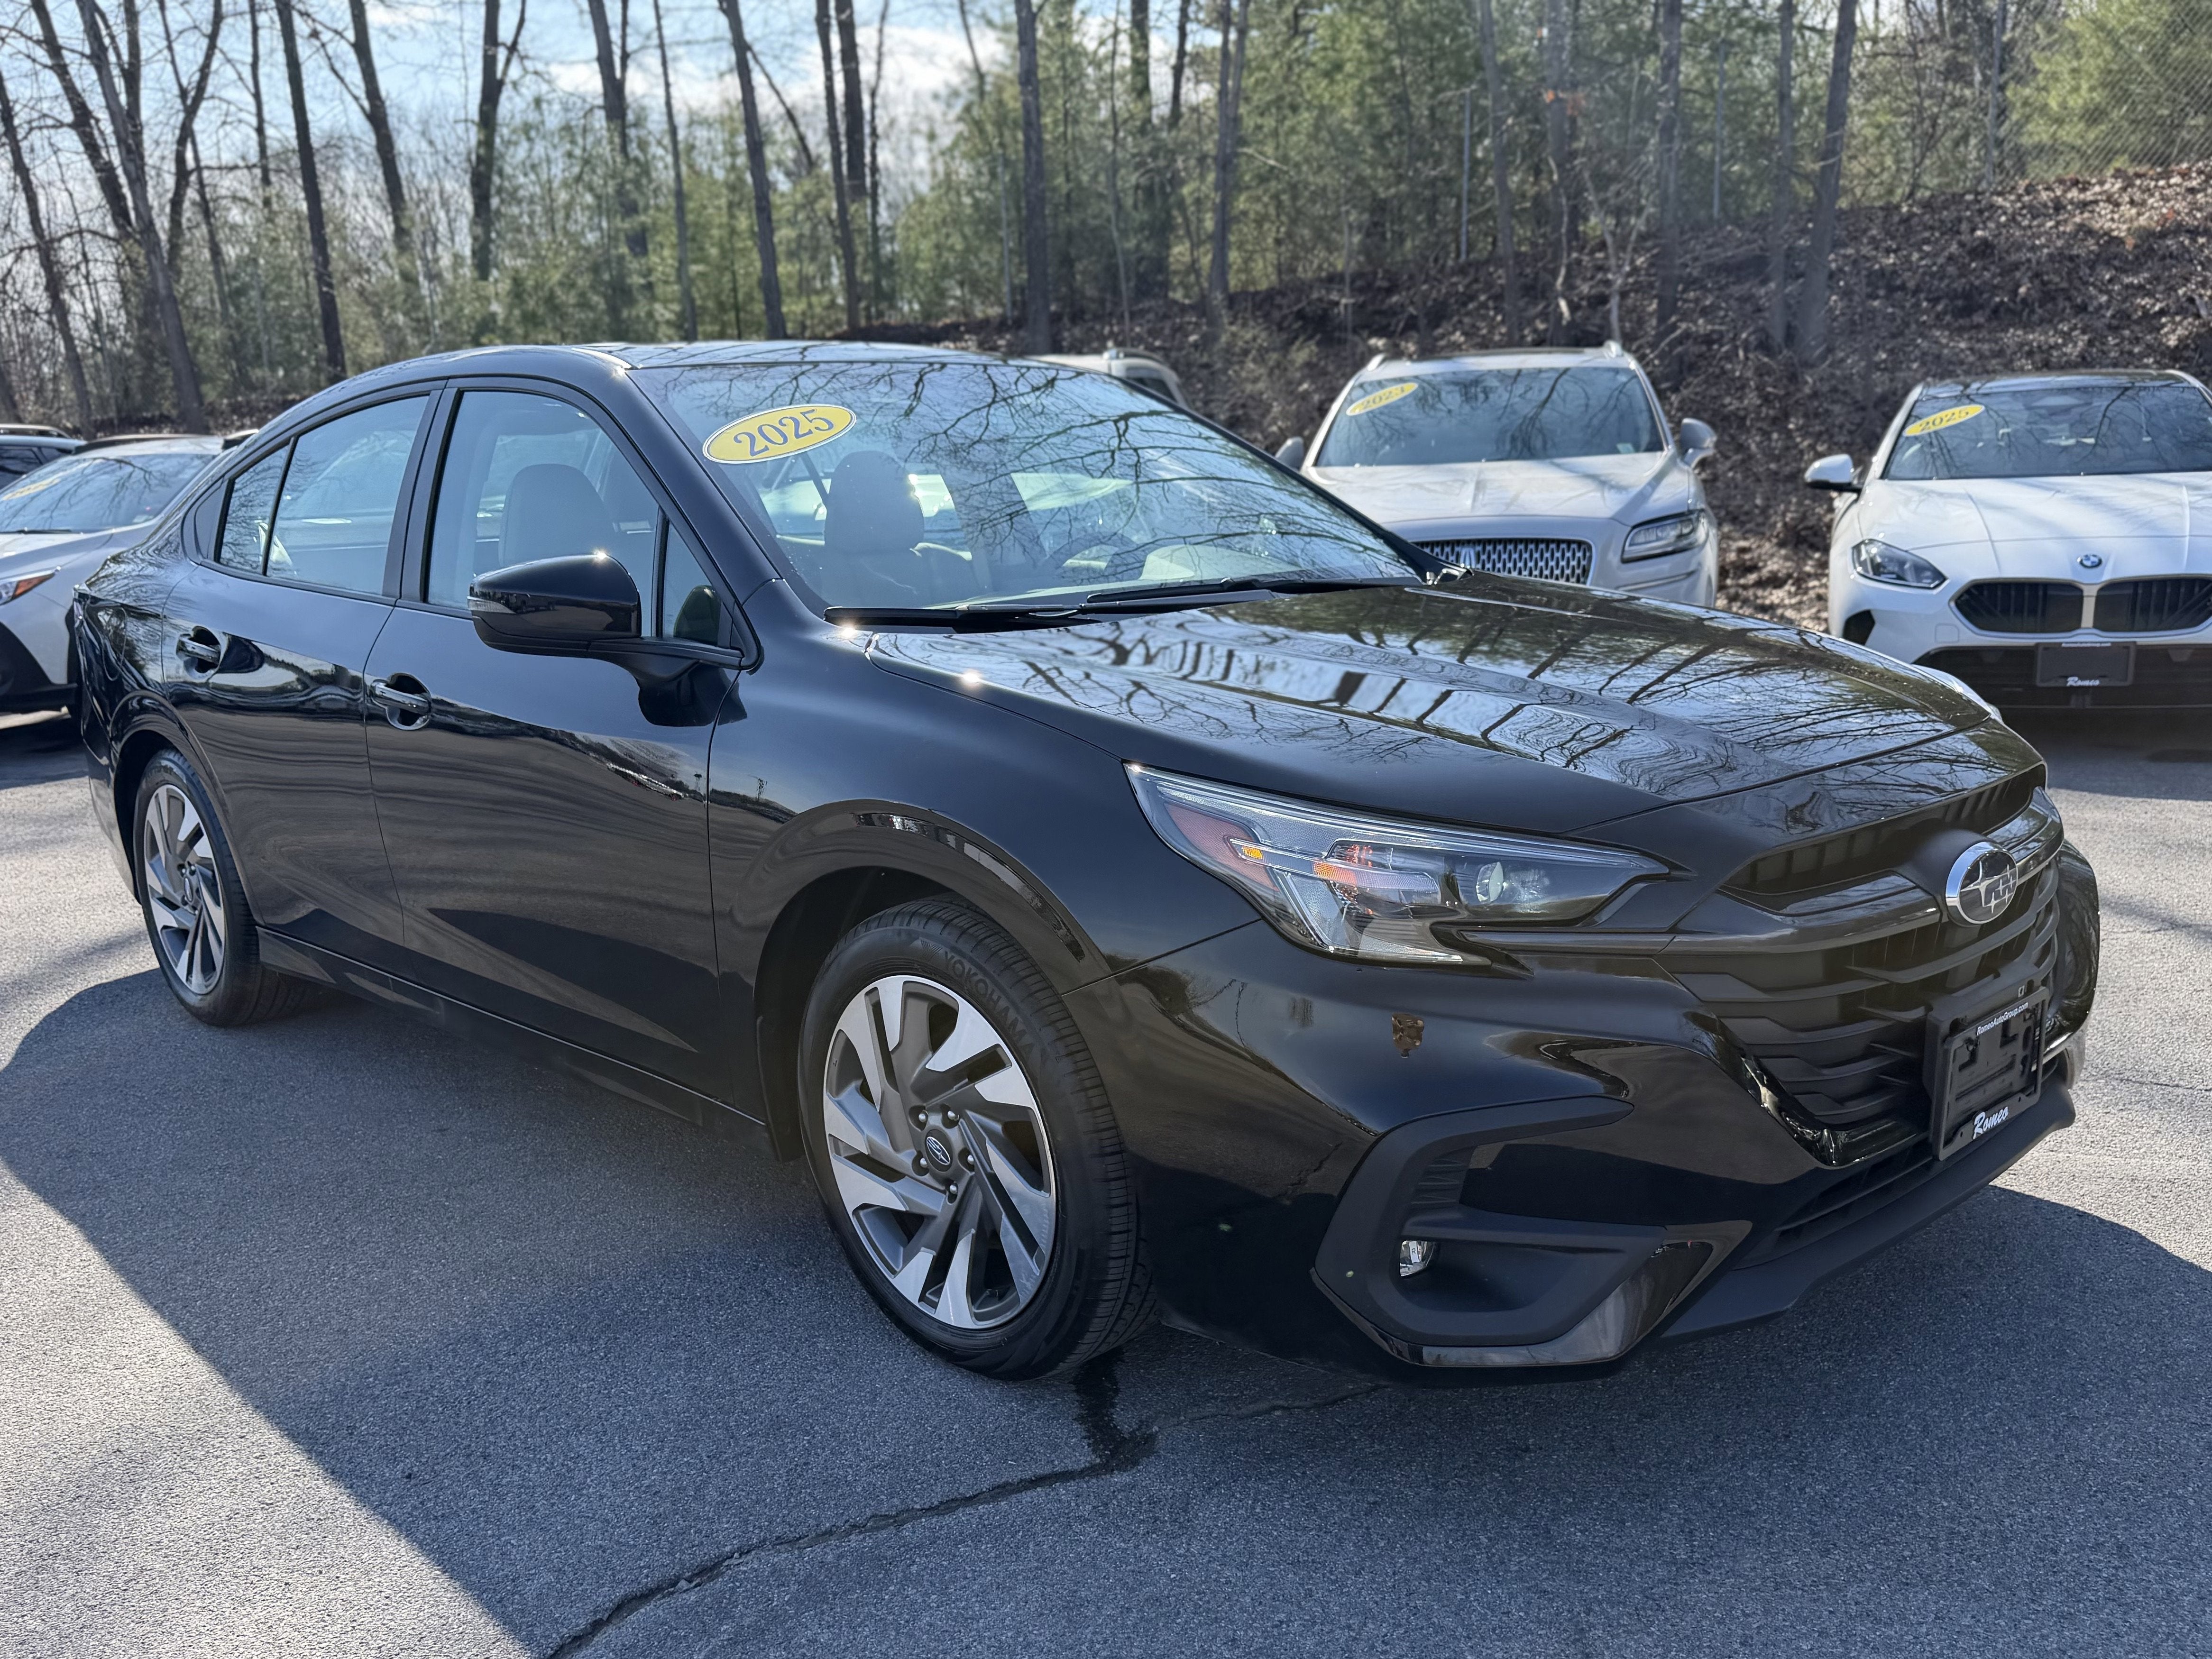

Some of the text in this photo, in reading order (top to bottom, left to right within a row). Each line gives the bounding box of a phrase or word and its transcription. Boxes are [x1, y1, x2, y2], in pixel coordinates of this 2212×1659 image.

[734, 409, 834, 457] 2025
[1920, 408, 1969, 432] 2025
[2066, 677, 2100, 687] Romeo
[944, 950, 1035, 1058] YOKOHAMA
[1976, 1002, 2028, 1036] RomeoAutoGroup.com
[1973, 1106, 2009, 1139] Romeo
